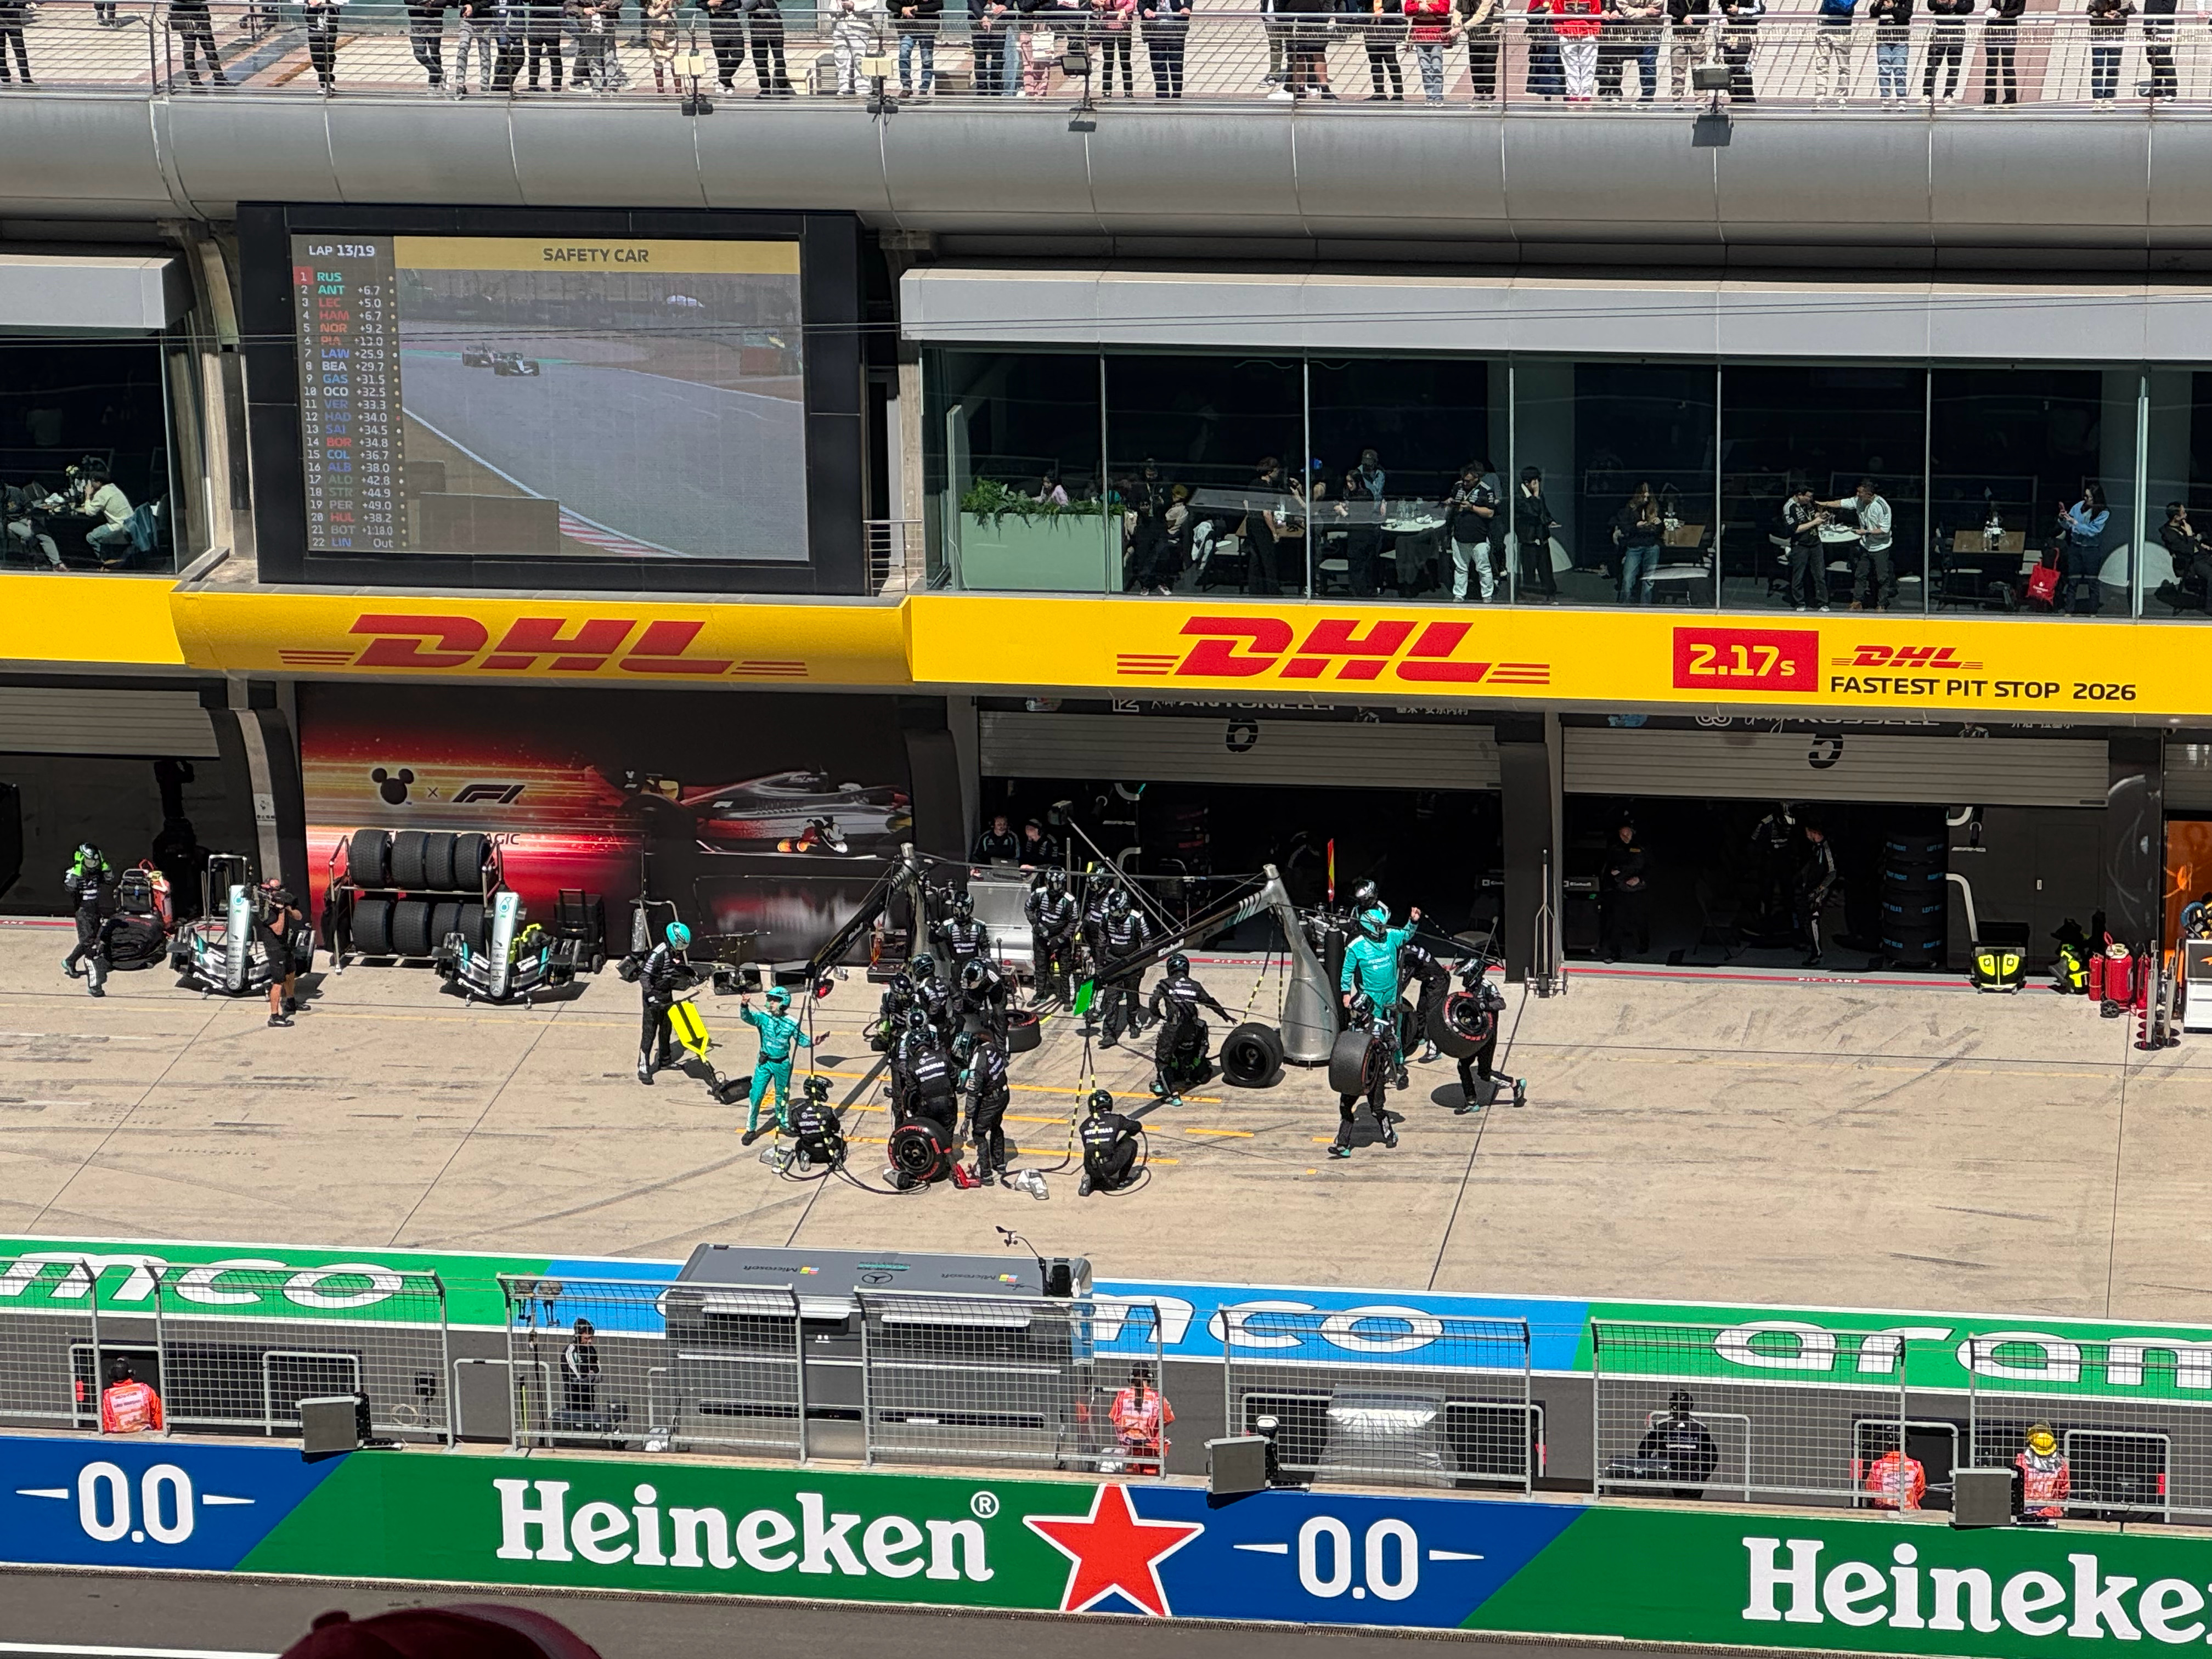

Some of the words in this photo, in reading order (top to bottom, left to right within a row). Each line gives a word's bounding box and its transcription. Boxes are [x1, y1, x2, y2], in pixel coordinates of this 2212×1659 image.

[309, 245, 332, 256] LAP
[337, 245, 375, 257] 13/19
[543, 248, 611, 262] SAFETY
[615, 248, 649, 263] CAR
[300, 272, 307, 281] 1
[317, 272, 342, 281] RUS
[301, 285, 307, 294] 2
[318, 285, 345, 295] ANT
[358, 286, 380, 295] +6.7
[302, 298, 308, 307] 3
[319, 298, 341, 308] LEC
[358, 298, 381, 308] +5.0
[303, 311, 309, 319] 4
[319, 311, 349, 320] HAM
[359, 311, 381, 321] +6.7
[303, 323, 310, 332] 5
[320, 323, 347, 332] NOR
[360, 324, 382, 334] +9.2
[304, 336, 311, 345] 6
[320, 336, 342, 346] PIA
[304, 349, 311, 357] 7
[321, 349, 349, 358] LAW
[355, 349, 383, 359] +25.9
[306, 362, 312, 370] 8
[322, 362, 347, 371] BEA
[356, 362, 384, 371] +29.7
[306, 374, 313, 382] 9
[323, 374, 348, 383] GAS
[356, 375, 385, 384] +31.5
[304, 387, 317, 396] 10
[323, 387, 348, 396] OCO
[357, 387, 386, 397] +32.5
[305, 399, 317, 408] 11
[324, 399, 348, 409] VER
[357, 400, 386, 409] +33.3
[306, 412, 318, 421] 12
[325, 412, 351, 421] HAD
[358, 413, 387, 422] +34.0
[306, 425, 319, 433] 13
[325, 425, 346, 434] SAI
[359, 425, 387, 435] +34.5
[307, 437, 319, 446] 14
[326, 437, 352, 447] BOR
[359, 438, 388, 448] +34.8
[308, 450, 320, 459] 15
[327, 450, 350, 459] COL
[360, 450, 388, 460] +36.7
[308, 462, 320, 471] 16
[328, 462, 352, 472] ALB
[361, 463, 390, 473] +38.0
[309, 475, 321, 484] 17
[329, 475, 353, 484] ALO
[362, 476, 390, 486] +42.8
[309, 488, 322, 496] 18
[329, 488, 353, 497] STR
[362, 488, 391, 498] +44.9
[311, 500, 323, 509] 19
[330, 500, 353, 509] PER
[363, 501, 391, 510] +49.0
[311, 513, 323, 522] 20
[330, 512, 355, 522] HUL
[363, 514, 392, 523] +38.2
[312, 525, 324, 534] 21
[331, 525, 356, 534] BOT
[313, 538, 325, 546] 22
[331, 538, 351, 547] LIN
[374, 539, 394, 548] Out
[349, 614, 732, 674] DHL
[1173, 616, 1493, 683] DHL
[1689, 644, 1796, 676] 2.17s
[1852, 645, 1963, 669] DHL
[1831, 676, 1940, 695] FASTEST
[1947, 680, 1988, 697] PIT
[1995, 681, 2060, 699] STOP
[2073, 683, 2136, 701] 2026
[452, 785, 526, 804] F1
[78, 1462, 194, 1544] 0.0
[493, 1479, 995, 1582] Heineken
[1299, 1516, 1418, 1601] 0.0
[1742, 1537, 2212, 1644] Heineke
